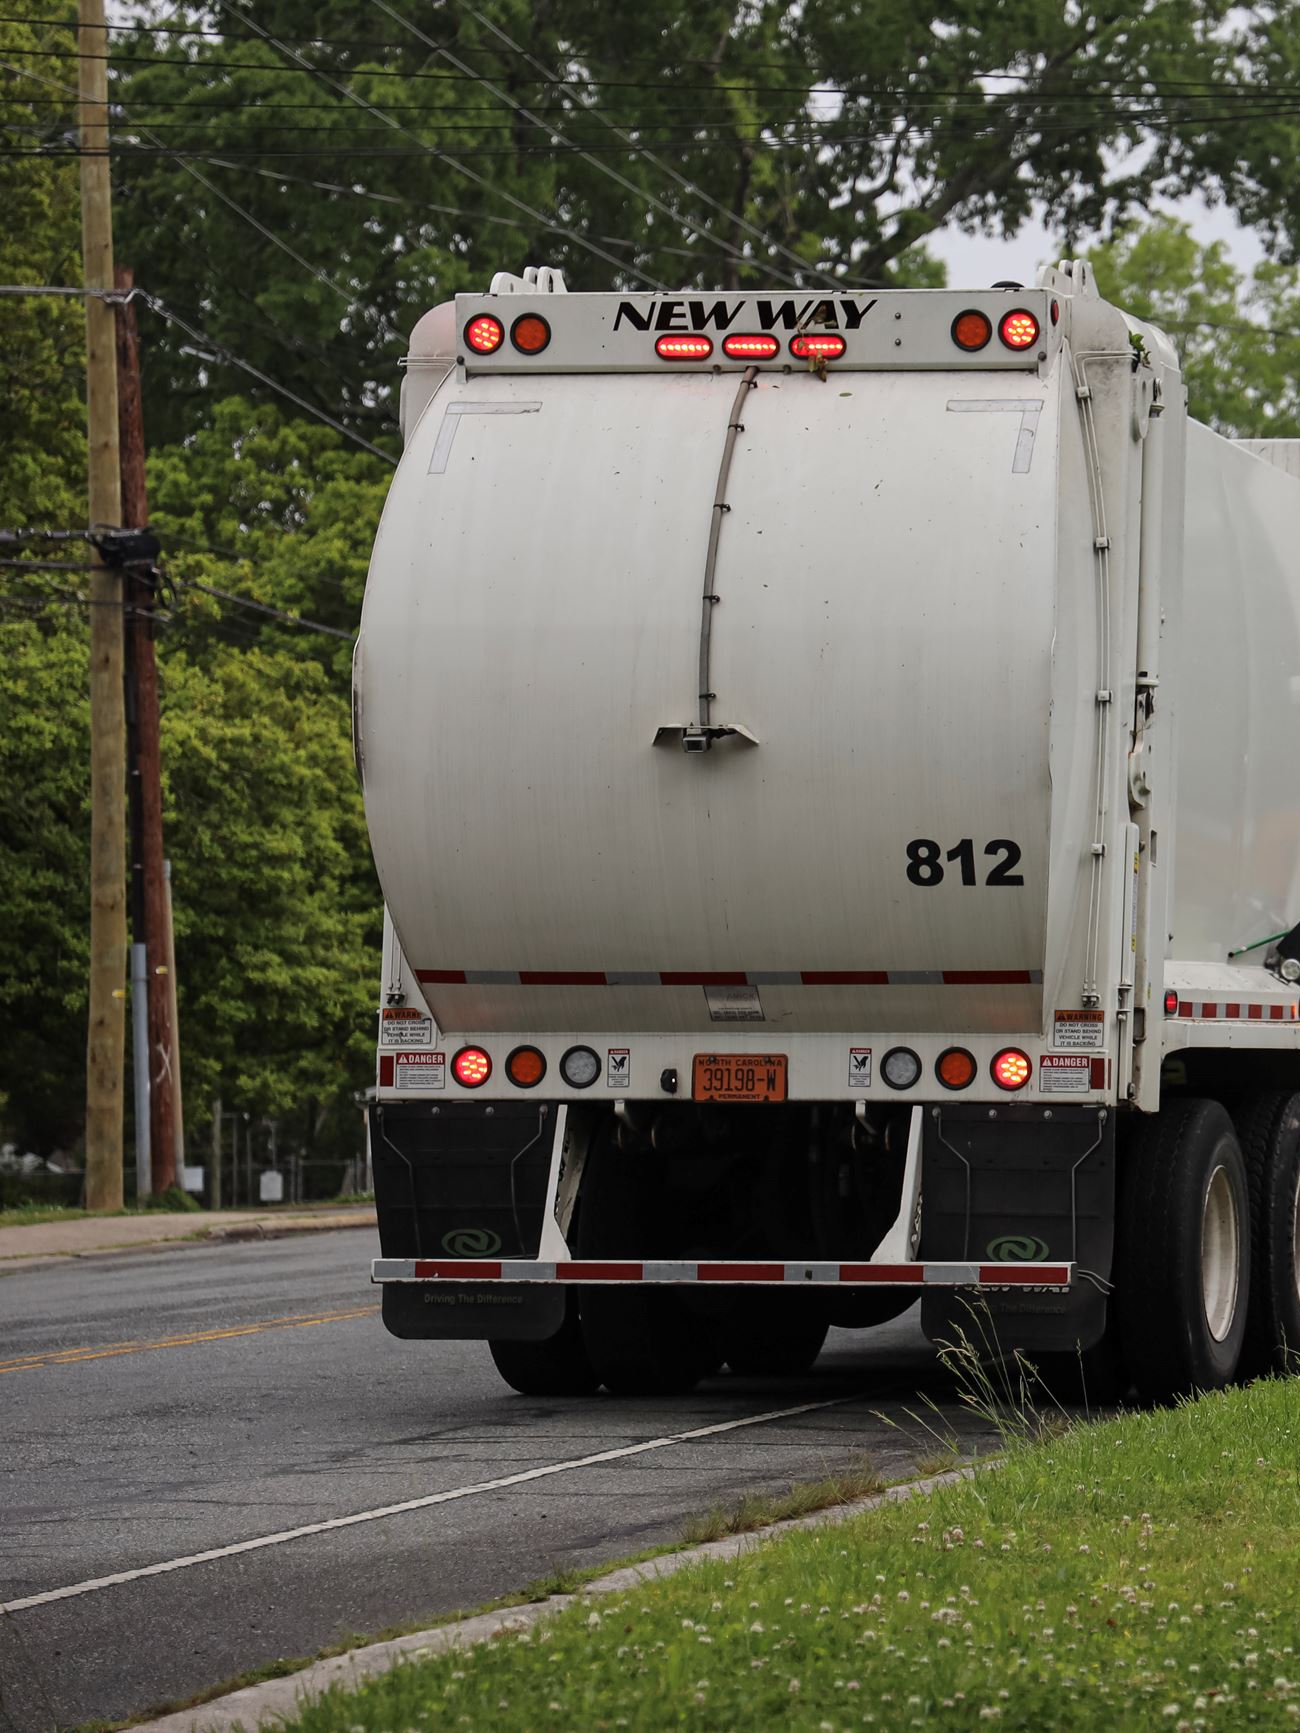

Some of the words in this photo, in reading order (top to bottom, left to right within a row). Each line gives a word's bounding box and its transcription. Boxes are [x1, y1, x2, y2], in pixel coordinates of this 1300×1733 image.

[613, 300, 746, 331] NEW
[756, 299, 879, 330] WAY
[906, 838, 1025, 887] 812
[1067, 1013, 1102, 1021] WARNING
[408, 1054, 444, 1064] DANGER
[1052, 1057, 1088, 1067] DANGER
[703, 1067, 777, 1092] 39198-W
[424, 1293, 456, 1306] Driving
[458, 1293, 475, 1305] The
[477, 1293, 523, 1305] Difference
